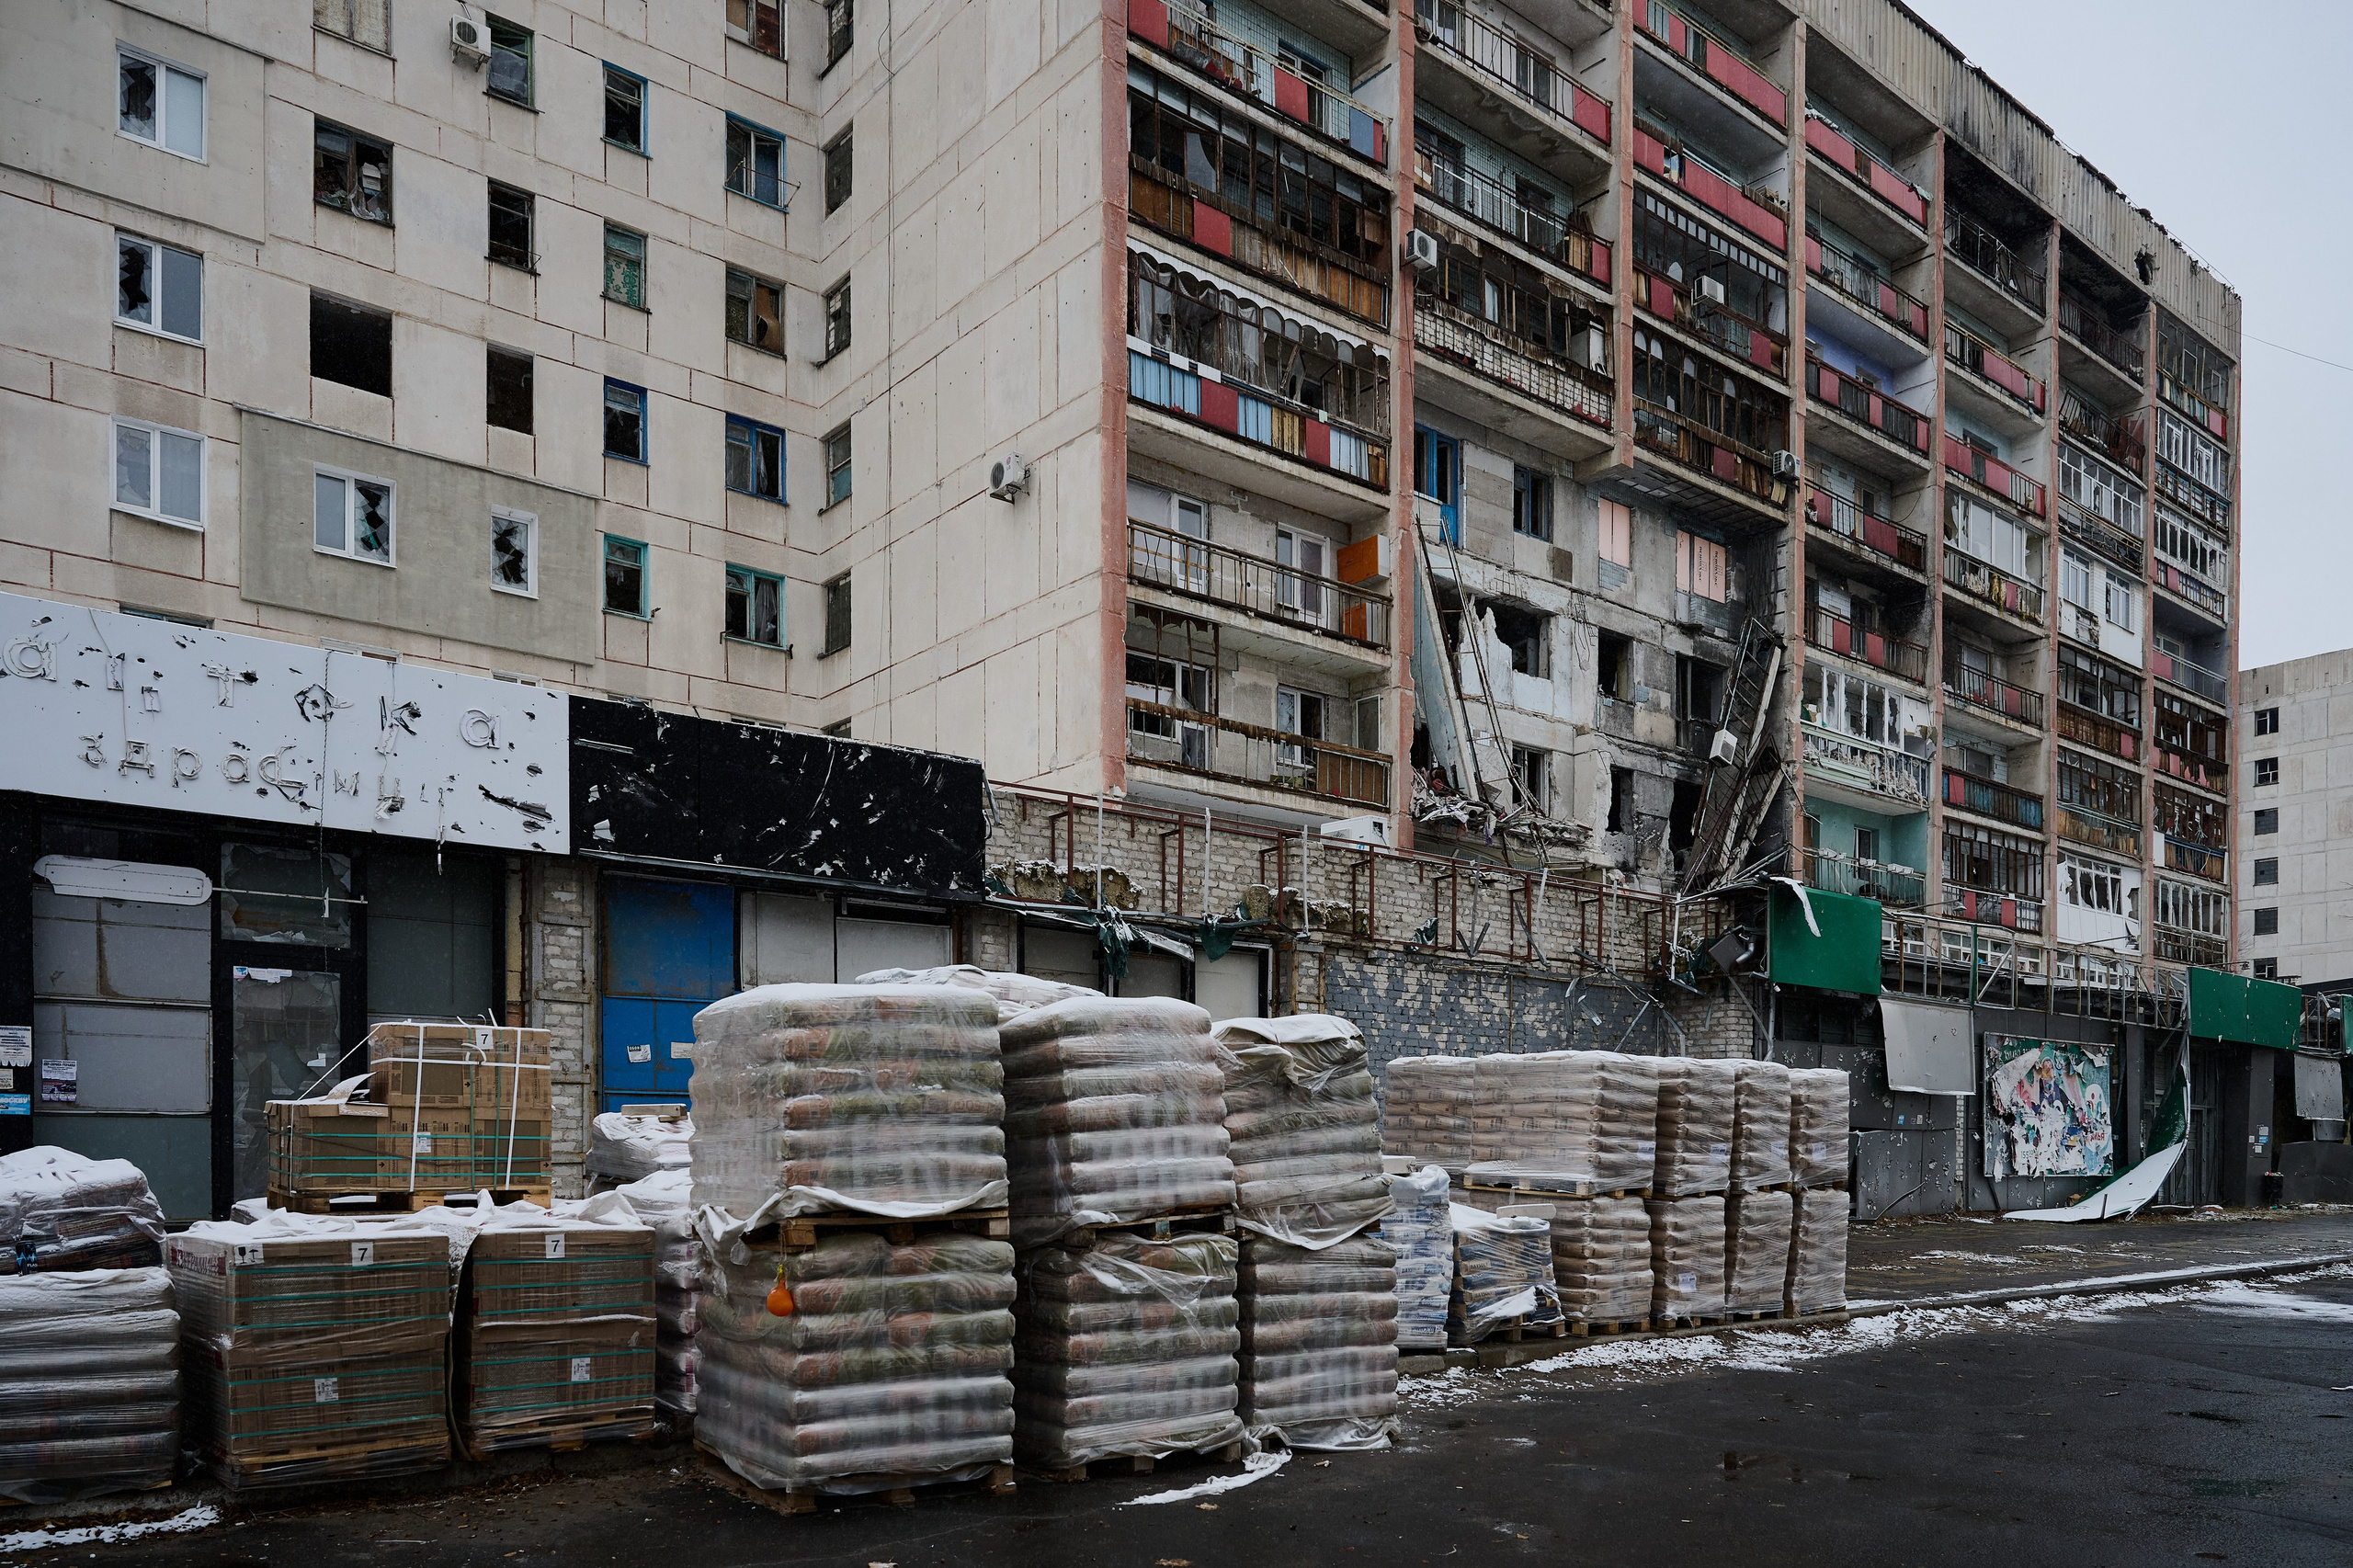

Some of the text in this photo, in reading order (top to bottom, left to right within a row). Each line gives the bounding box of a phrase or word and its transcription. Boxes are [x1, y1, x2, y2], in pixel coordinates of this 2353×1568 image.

[481, 1034, 488, 1044] 7
[551, 1240, 560, 1253] 7
[358, 1248, 368, 1261] 7
